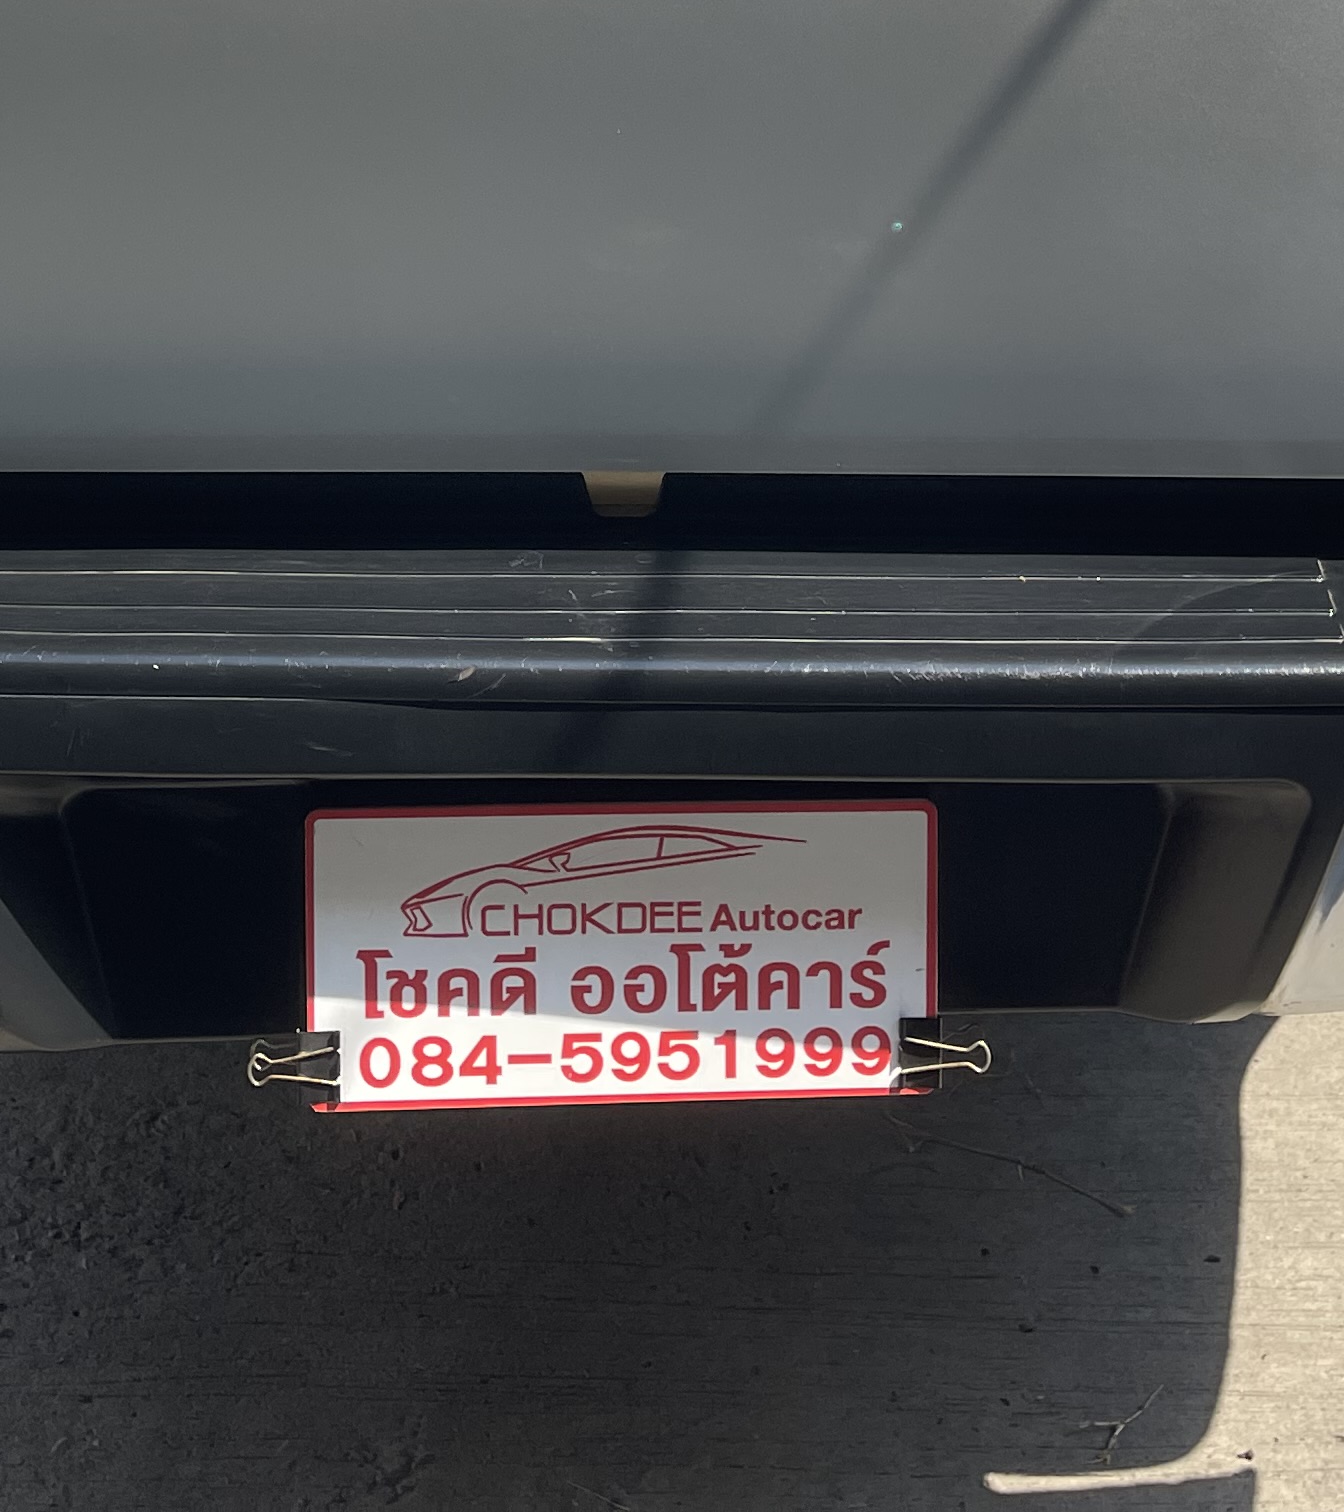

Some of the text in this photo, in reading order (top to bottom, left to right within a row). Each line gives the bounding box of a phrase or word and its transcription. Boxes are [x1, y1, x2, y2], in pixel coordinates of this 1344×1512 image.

[478, 900, 862, 937] CHOKDEE Autocar
[356, 939, 891, 1020] โชคดี ออโต้คาร์
[358, 1026, 892, 1088] 084-5951999
